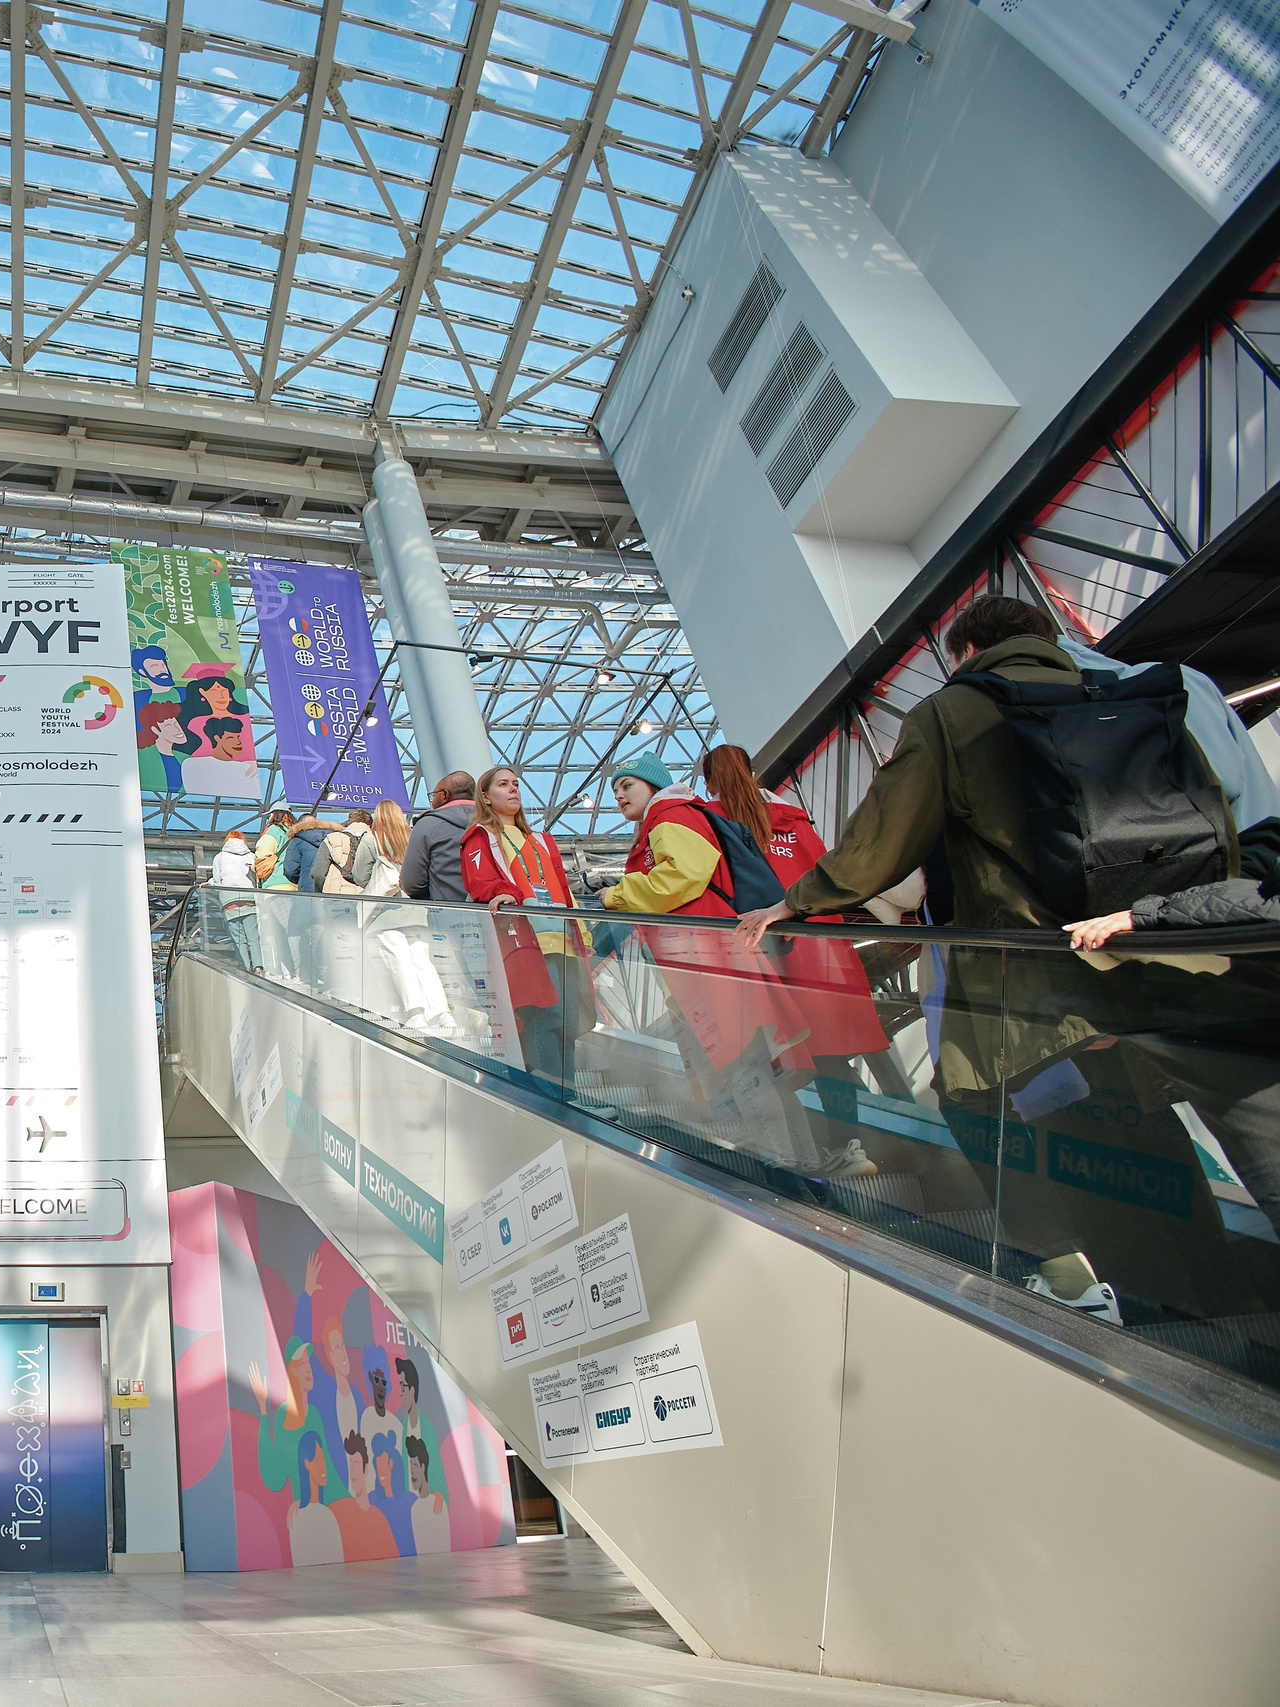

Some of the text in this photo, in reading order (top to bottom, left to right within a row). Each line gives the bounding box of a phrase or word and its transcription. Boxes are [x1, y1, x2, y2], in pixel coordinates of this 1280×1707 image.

[1119, 0, 1190, 99] ЭКОНОМИКА
[162, 554, 178, 625] fest2024.com
[176, 555, 196, 625] WELCOME!
[209, 581, 224, 631] rosmolodezh
[310, 596, 334, 668] WORLD TO
[325, 603, 351, 671] RUSSIA
[342, 687, 368, 754] WORLD
[311, 781, 383, 795] EXHIBITION
[333, 793, 369, 804] PACE
[323, 1130, 437, 1244] ВОЛНУ ТЕХНОЛОГИЙ
[537, 1191, 564, 1215] РОСАТОМ
[466, 1242, 482, 1261] СБЕР
[574, 1232, 606, 1255] Генеральный
[576, 1237, 620, 1263] образовательной
[530, 1264, 559, 1286] Официальный
[598, 1272, 628, 1289] Российское
[600, 1284, 625, 1301] общество
[602, 1296, 622, 1310] Знание
[542, 1303, 569, 1320] АЭРОФЛОТ
[576, 1359, 599, 1373] Партнёр
[633, 1344, 681, 1367] Стратегический
[579, 1363, 619, 1382] по устойчивому
[635, 1362, 660, 1377] партнёр
[581, 1379, 605, 1394] развитию
[667, 1395, 697, 1412] РОССЕТИ
[595, 1406, 632, 1429] СИБУР
[551, 1425, 580, 1439] Ростелеком
